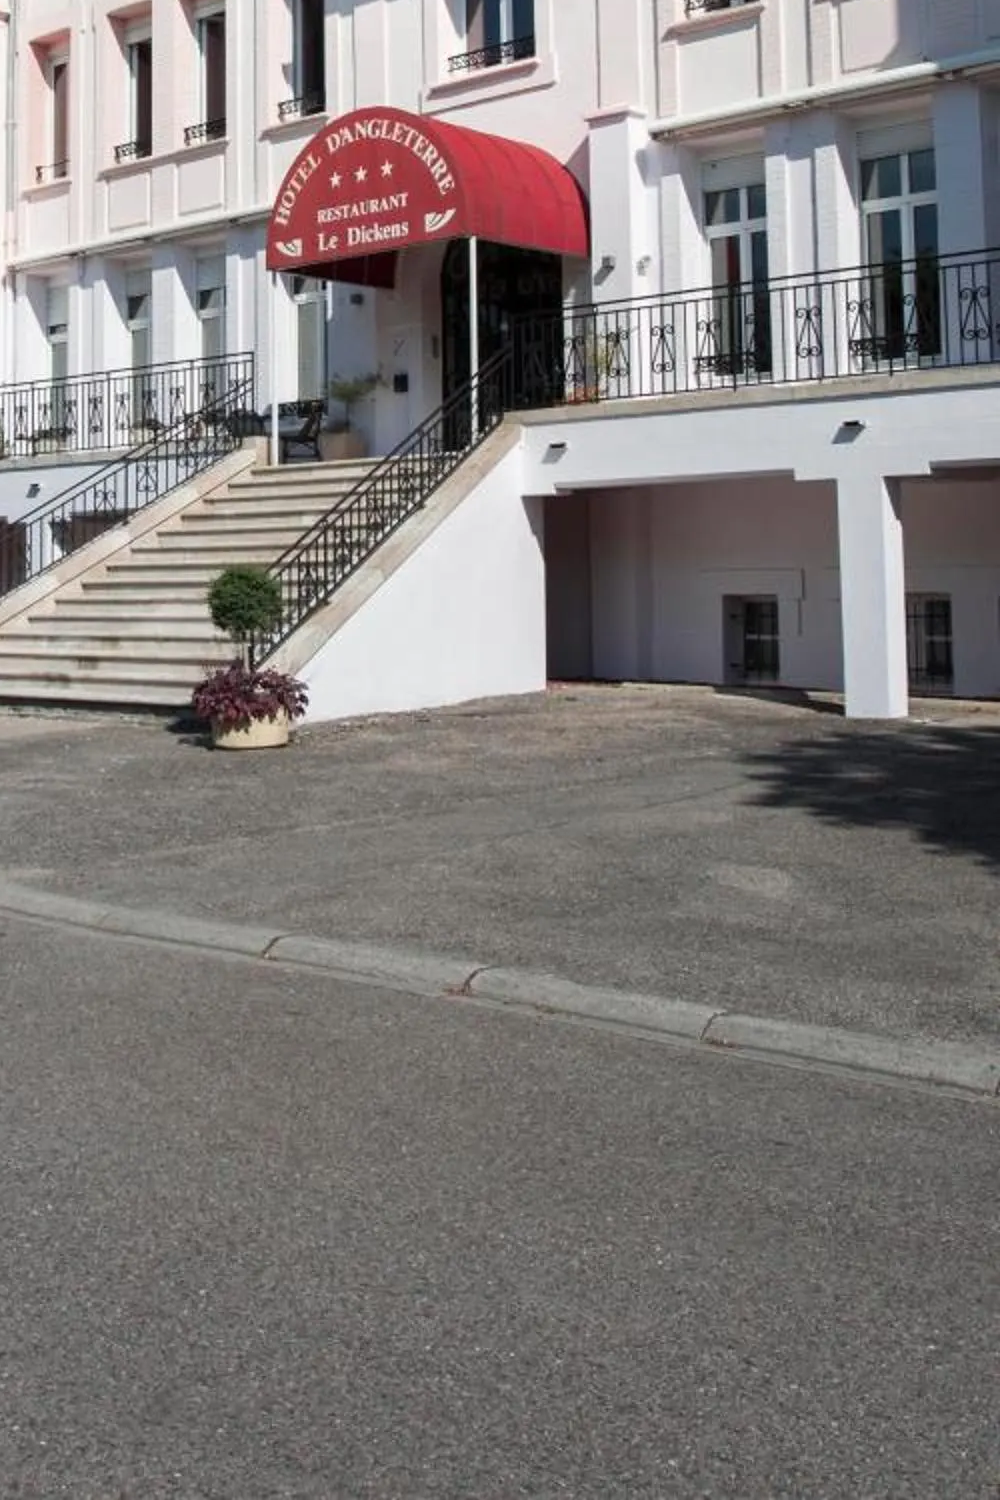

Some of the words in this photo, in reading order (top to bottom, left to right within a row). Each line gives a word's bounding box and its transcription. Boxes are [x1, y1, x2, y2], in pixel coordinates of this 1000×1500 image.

[274, 154, 322, 227] HOTEL
[326, 118, 456, 197] D'ANGLETERRE
[317, 192, 409, 224] RESTAURANT
[317, 232, 338, 251] Le
[347, 220, 410, 246] Dickens
